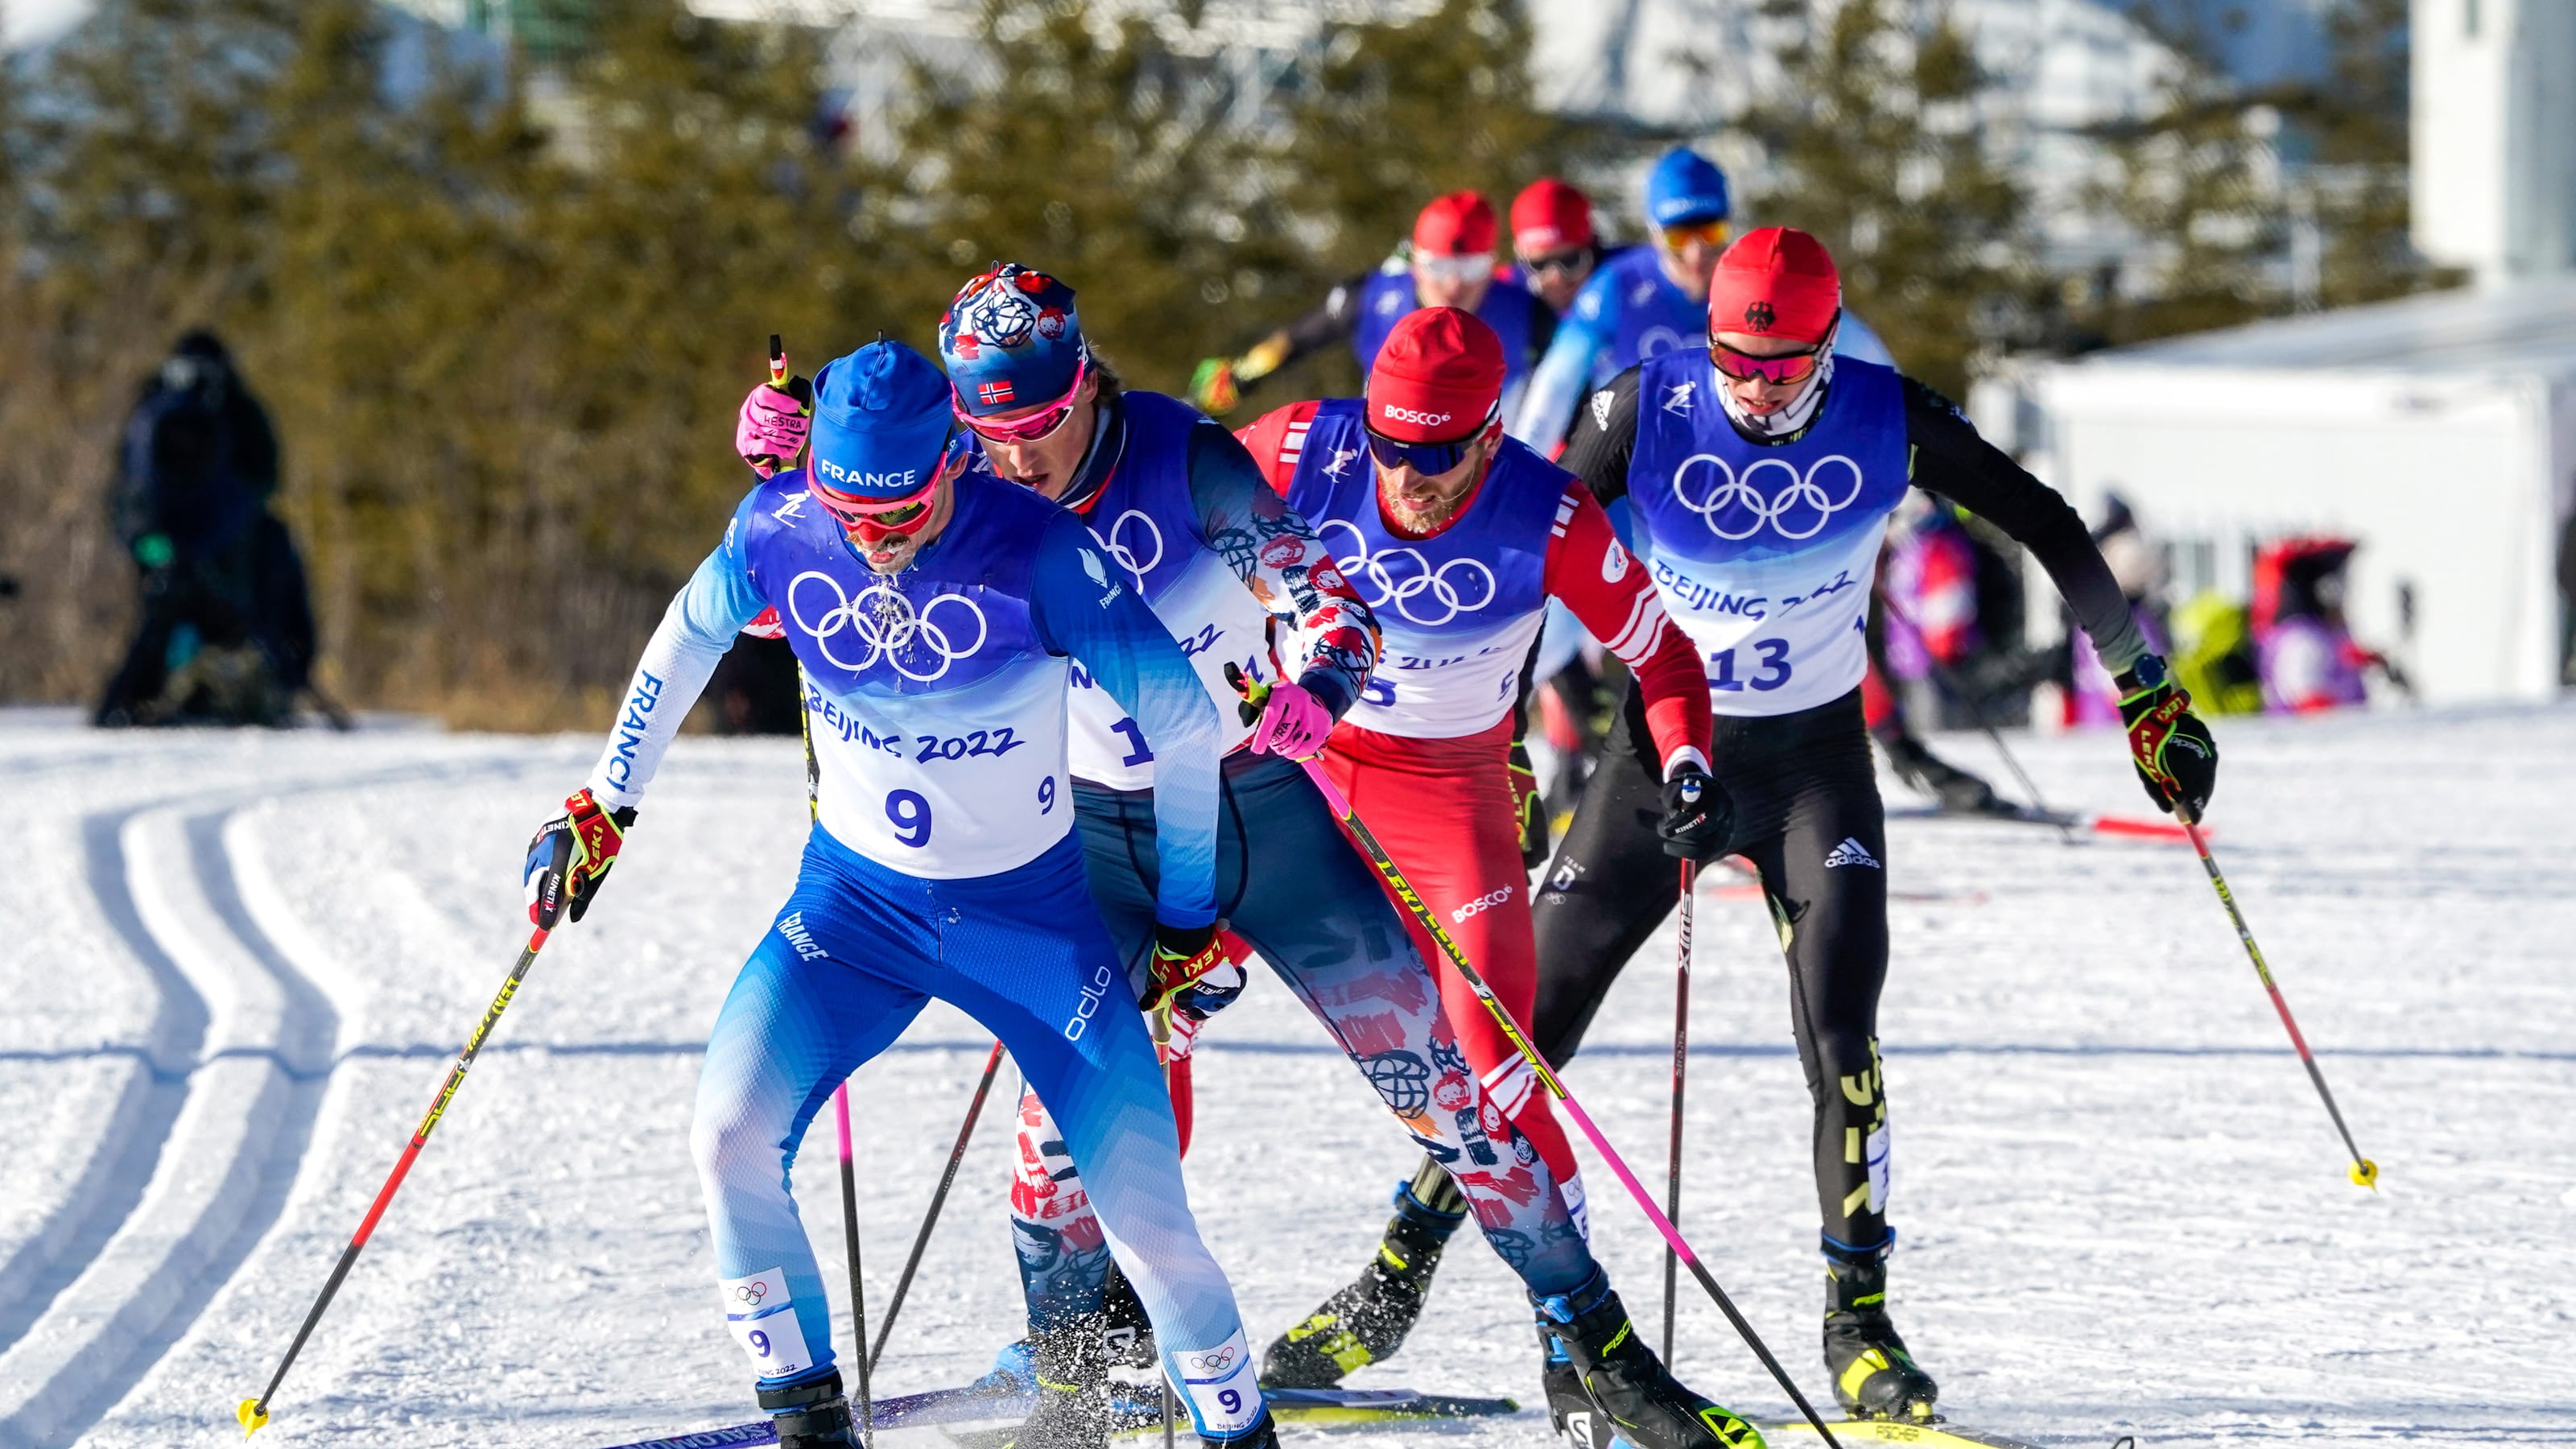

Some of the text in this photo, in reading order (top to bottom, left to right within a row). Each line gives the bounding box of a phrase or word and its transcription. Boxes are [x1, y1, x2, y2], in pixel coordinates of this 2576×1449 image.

[764, 415, 802, 429] HESTRA
[1384, 404, 1442, 426] BOSCO
[821, 459, 915, 488] FRANCE
[1099, 581, 1121, 609] FRANC
[1655, 559, 1769, 621] BEIJING
[1707, 638, 1792, 691] 13
[1360, 675, 1397, 707] 5
[806, 682, 902, 758] BEIJING
[916, 727, 1027, 764] 2022
[1038, 775, 1055, 815] 9
[885, 788, 932, 848] 9
[1675, 812, 1707, 835] KINETIX
[587, 825, 603, 873] LEKI
[1824, 854, 1881, 869] adidas
[544, 873, 562, 913] KINETIX
[1376, 861, 1425, 914] LEKI
[1451, 890, 1509, 924] BOSCO
[1183, 938, 1221, 978] LEKI
[1064, 965, 1111, 1042] odlo
[749, 1330, 770, 1358] 9
[776, 1364, 798, 1376] 2022
[1217, 1389, 1241, 1414] 9
[1216, 1422, 1245, 1431] BEIJING
